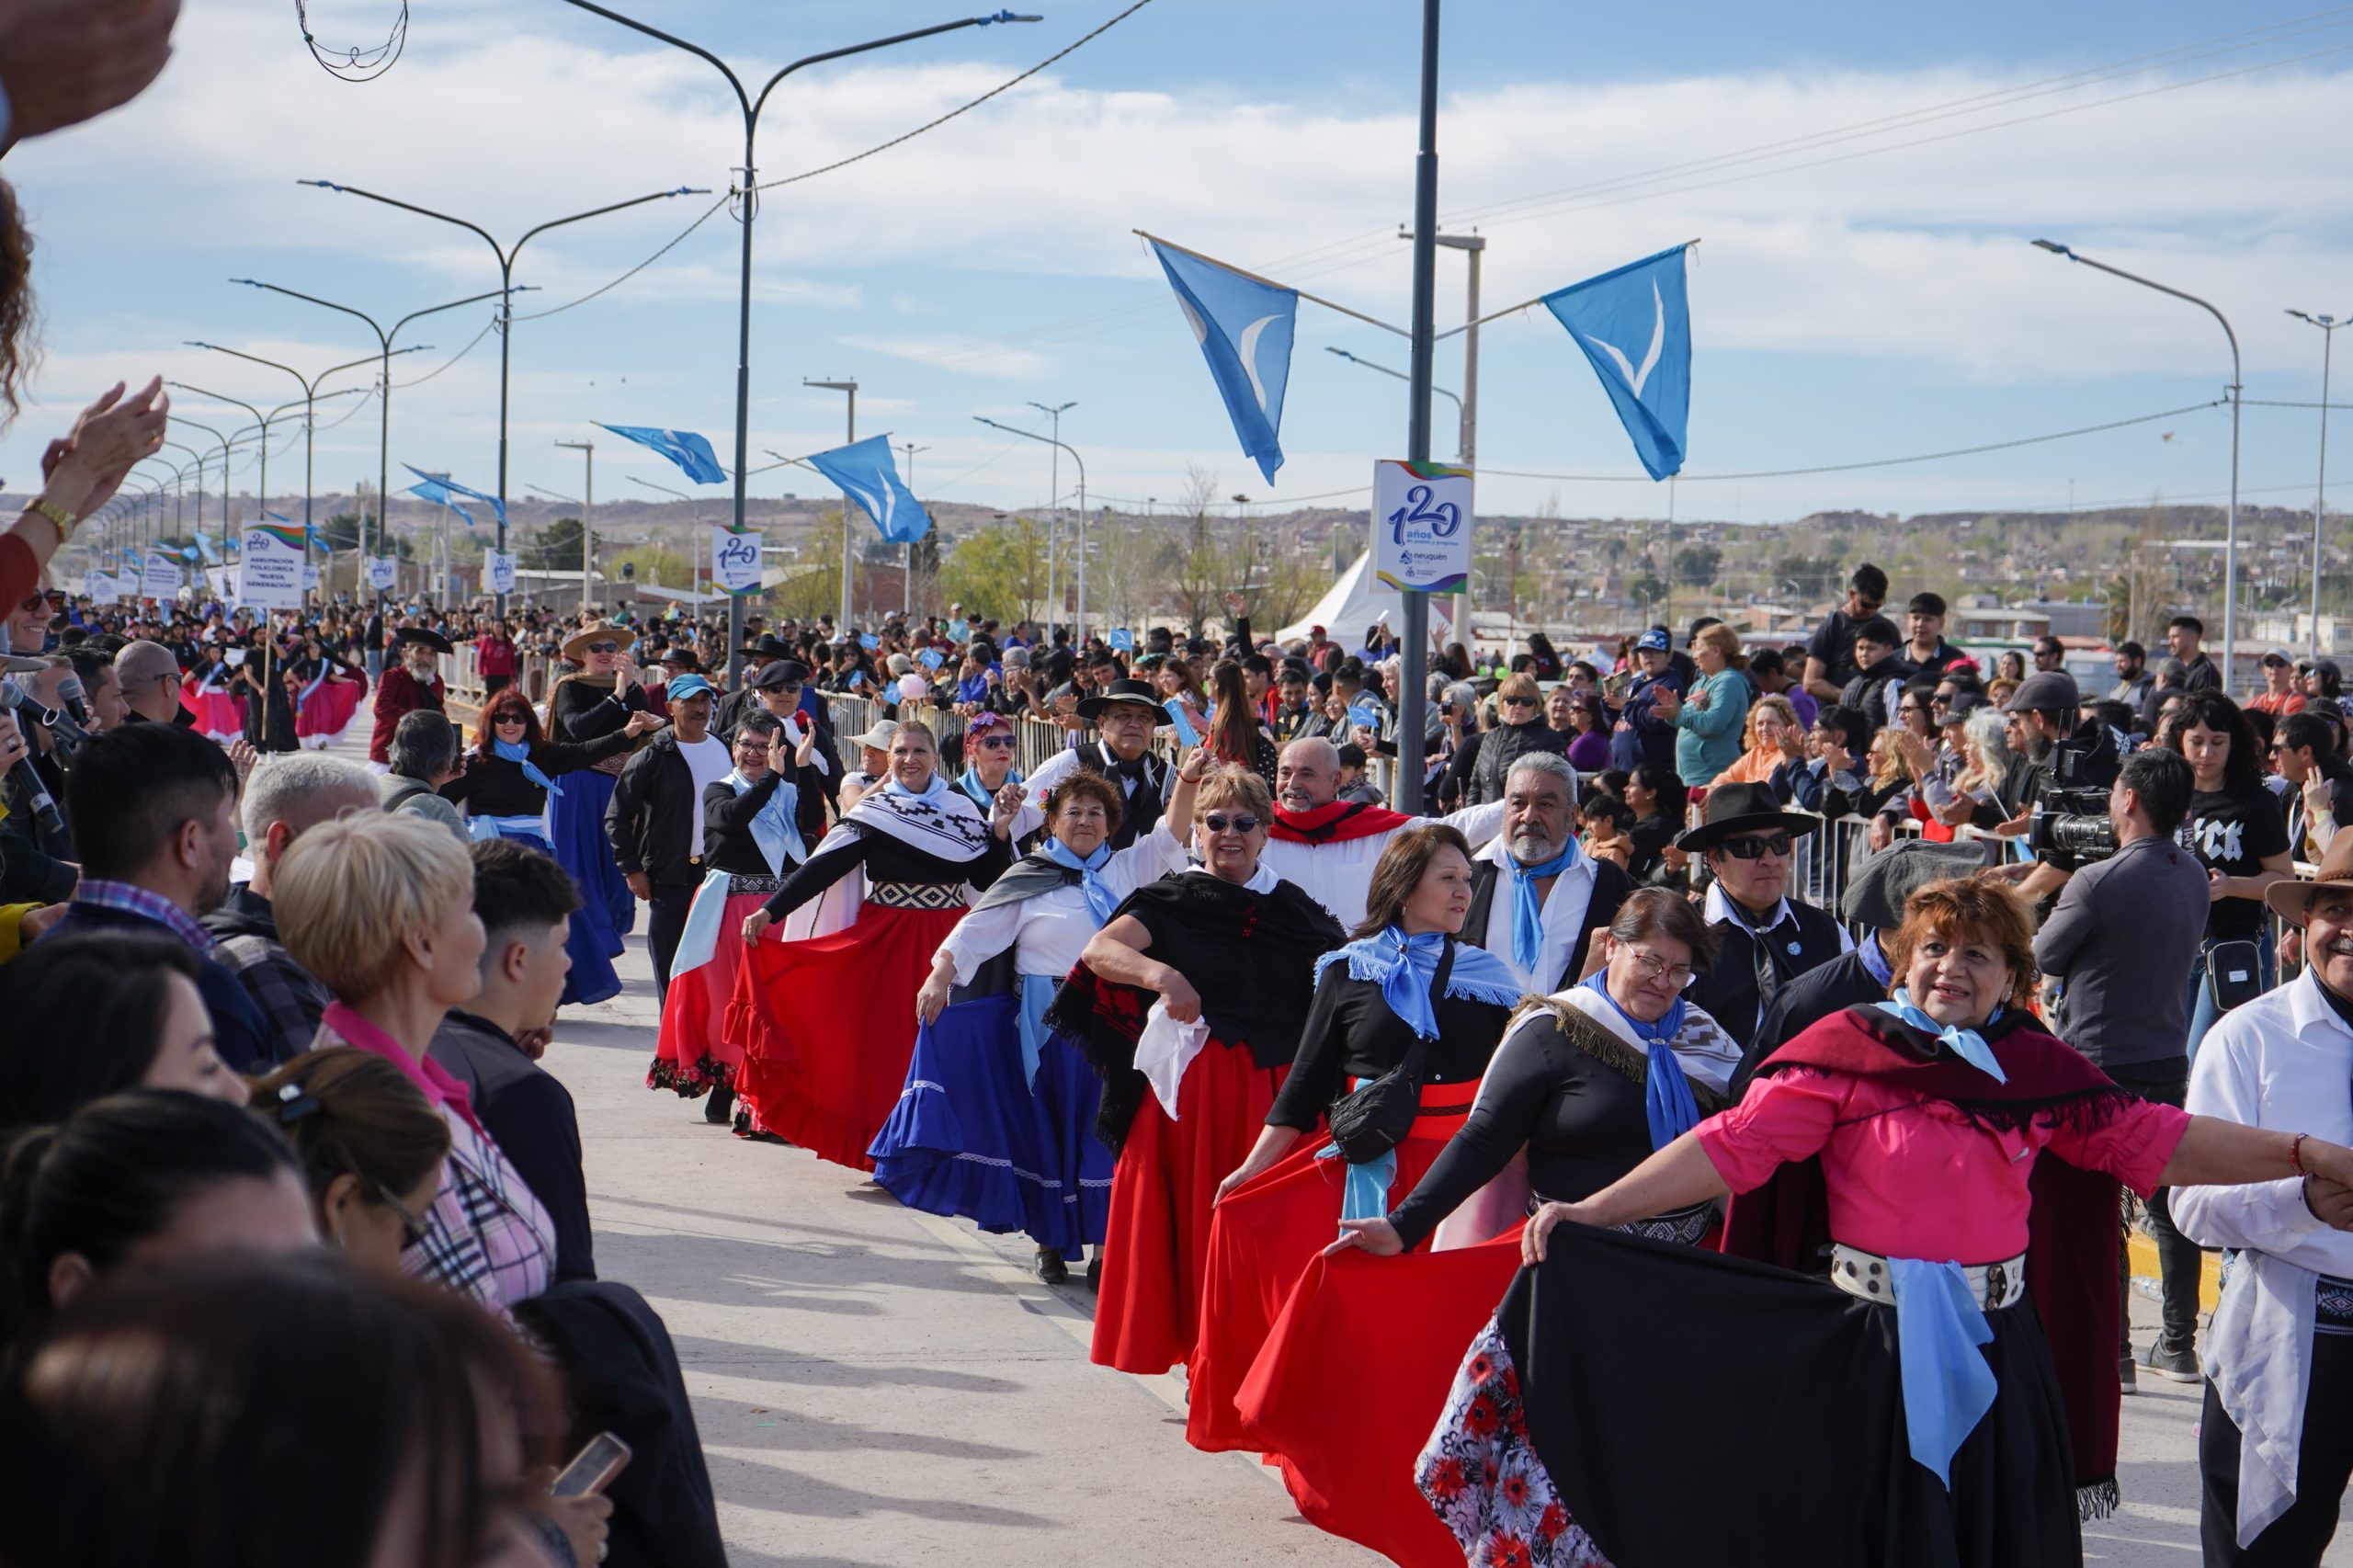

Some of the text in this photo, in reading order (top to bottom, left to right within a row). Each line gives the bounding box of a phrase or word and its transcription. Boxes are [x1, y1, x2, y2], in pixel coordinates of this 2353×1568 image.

[1388, 485, 1461, 546] 120
[1406, 529, 1432, 539] años
[718, 537, 756, 569] 120
[1414, 551, 1448, 561] neuquén
